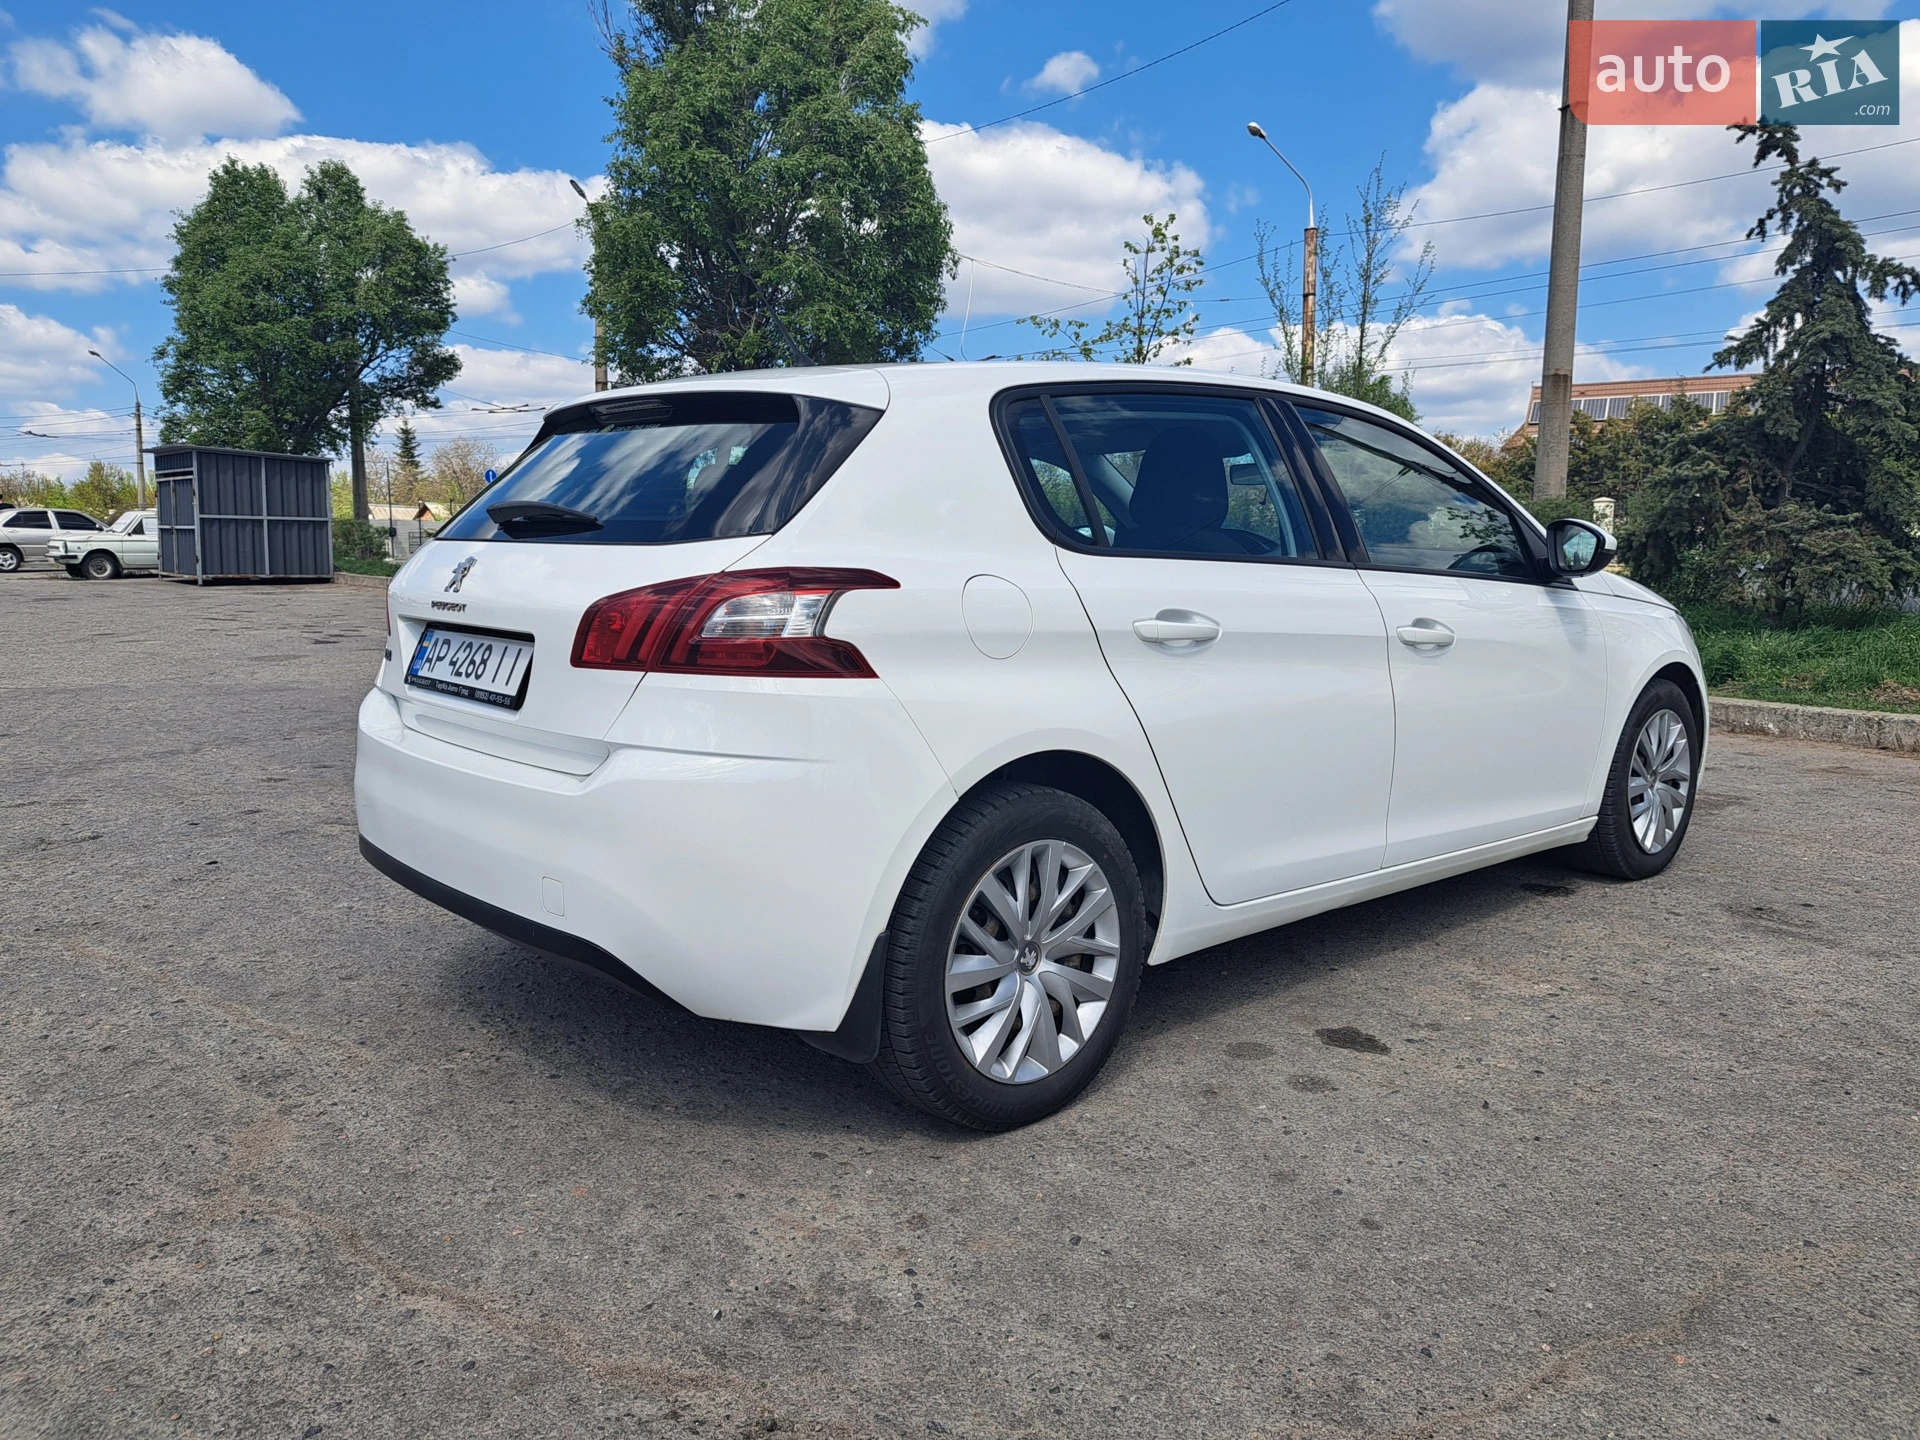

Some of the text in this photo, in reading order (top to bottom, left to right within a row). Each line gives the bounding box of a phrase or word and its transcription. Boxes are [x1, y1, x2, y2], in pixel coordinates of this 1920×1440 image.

[431, 600, 467, 613] PEUGEOT
[413, 658, 423, 669] UA
[420, 637, 452, 673] AP
[448, 640, 493, 680] 4268
[924, 1032, 1028, 1118] BRIDGESTONE
